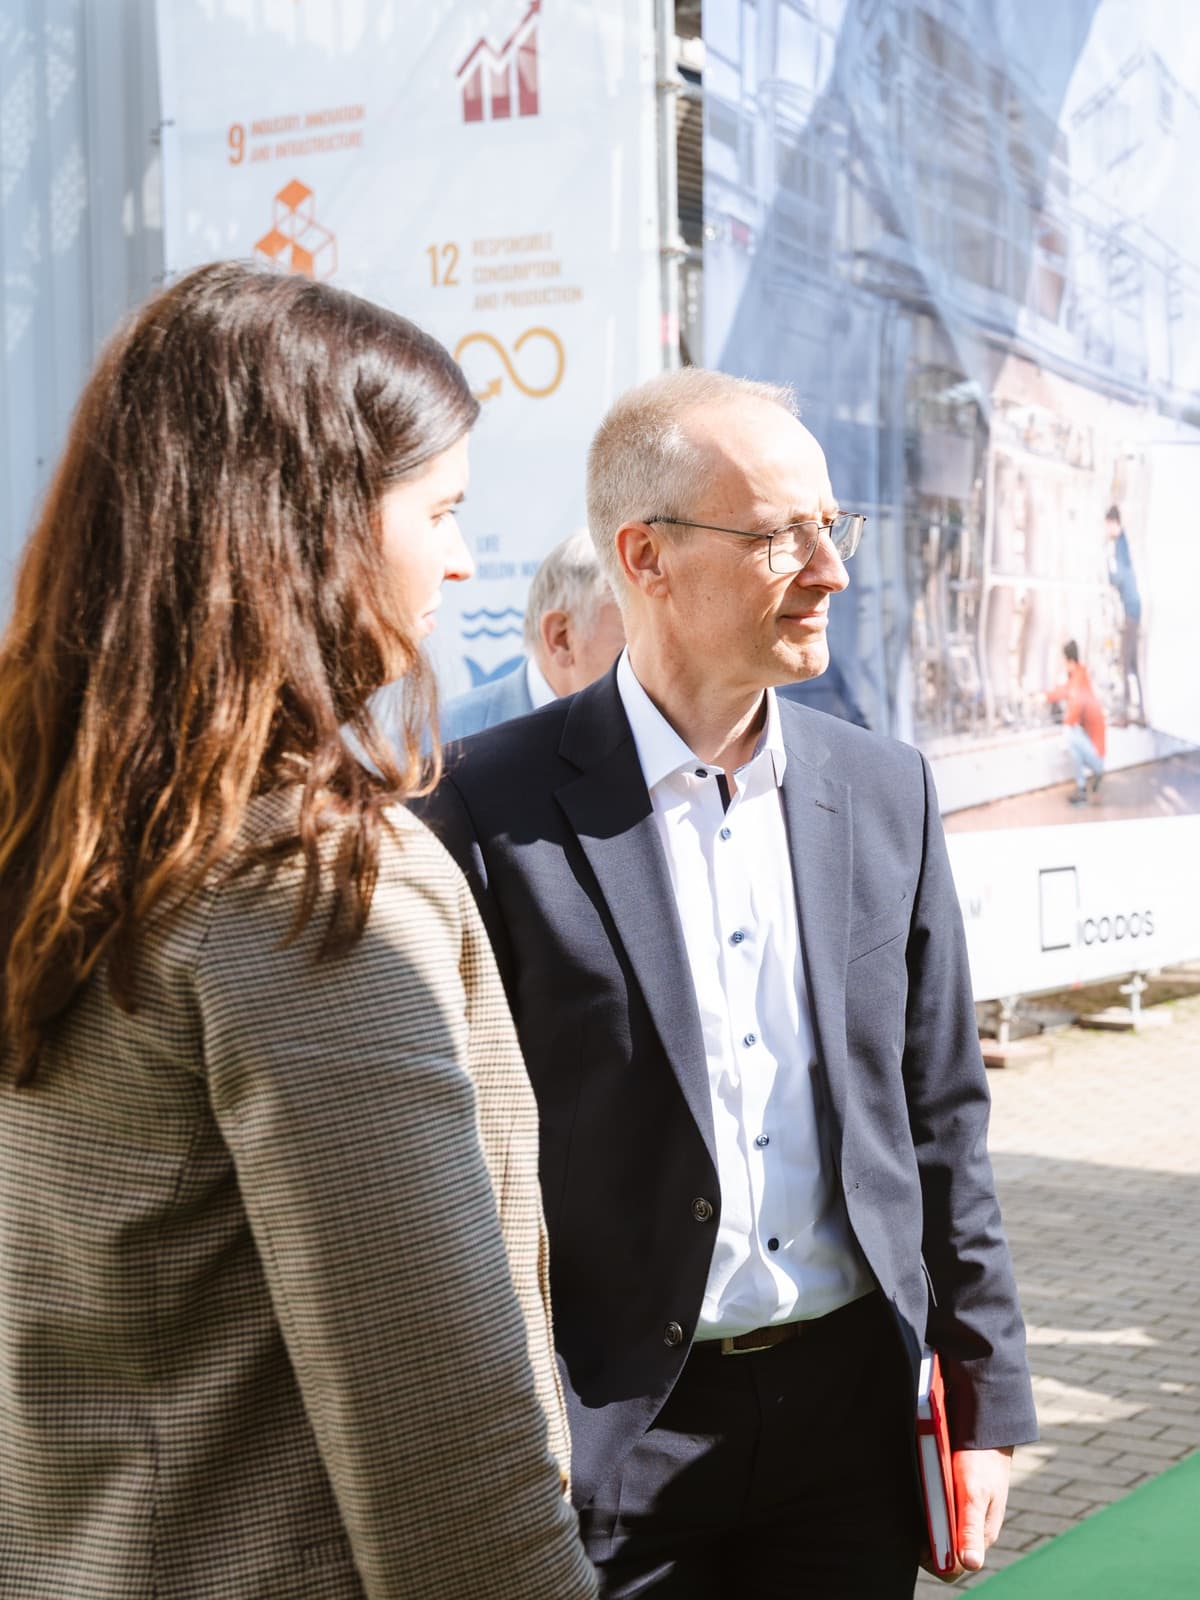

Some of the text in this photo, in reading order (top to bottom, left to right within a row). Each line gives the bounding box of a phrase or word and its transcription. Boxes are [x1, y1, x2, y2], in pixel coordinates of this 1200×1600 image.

[228, 122, 245, 167] 9
[425, 240, 461, 288] 12
[1077, 909, 1154, 947] ICODOS
